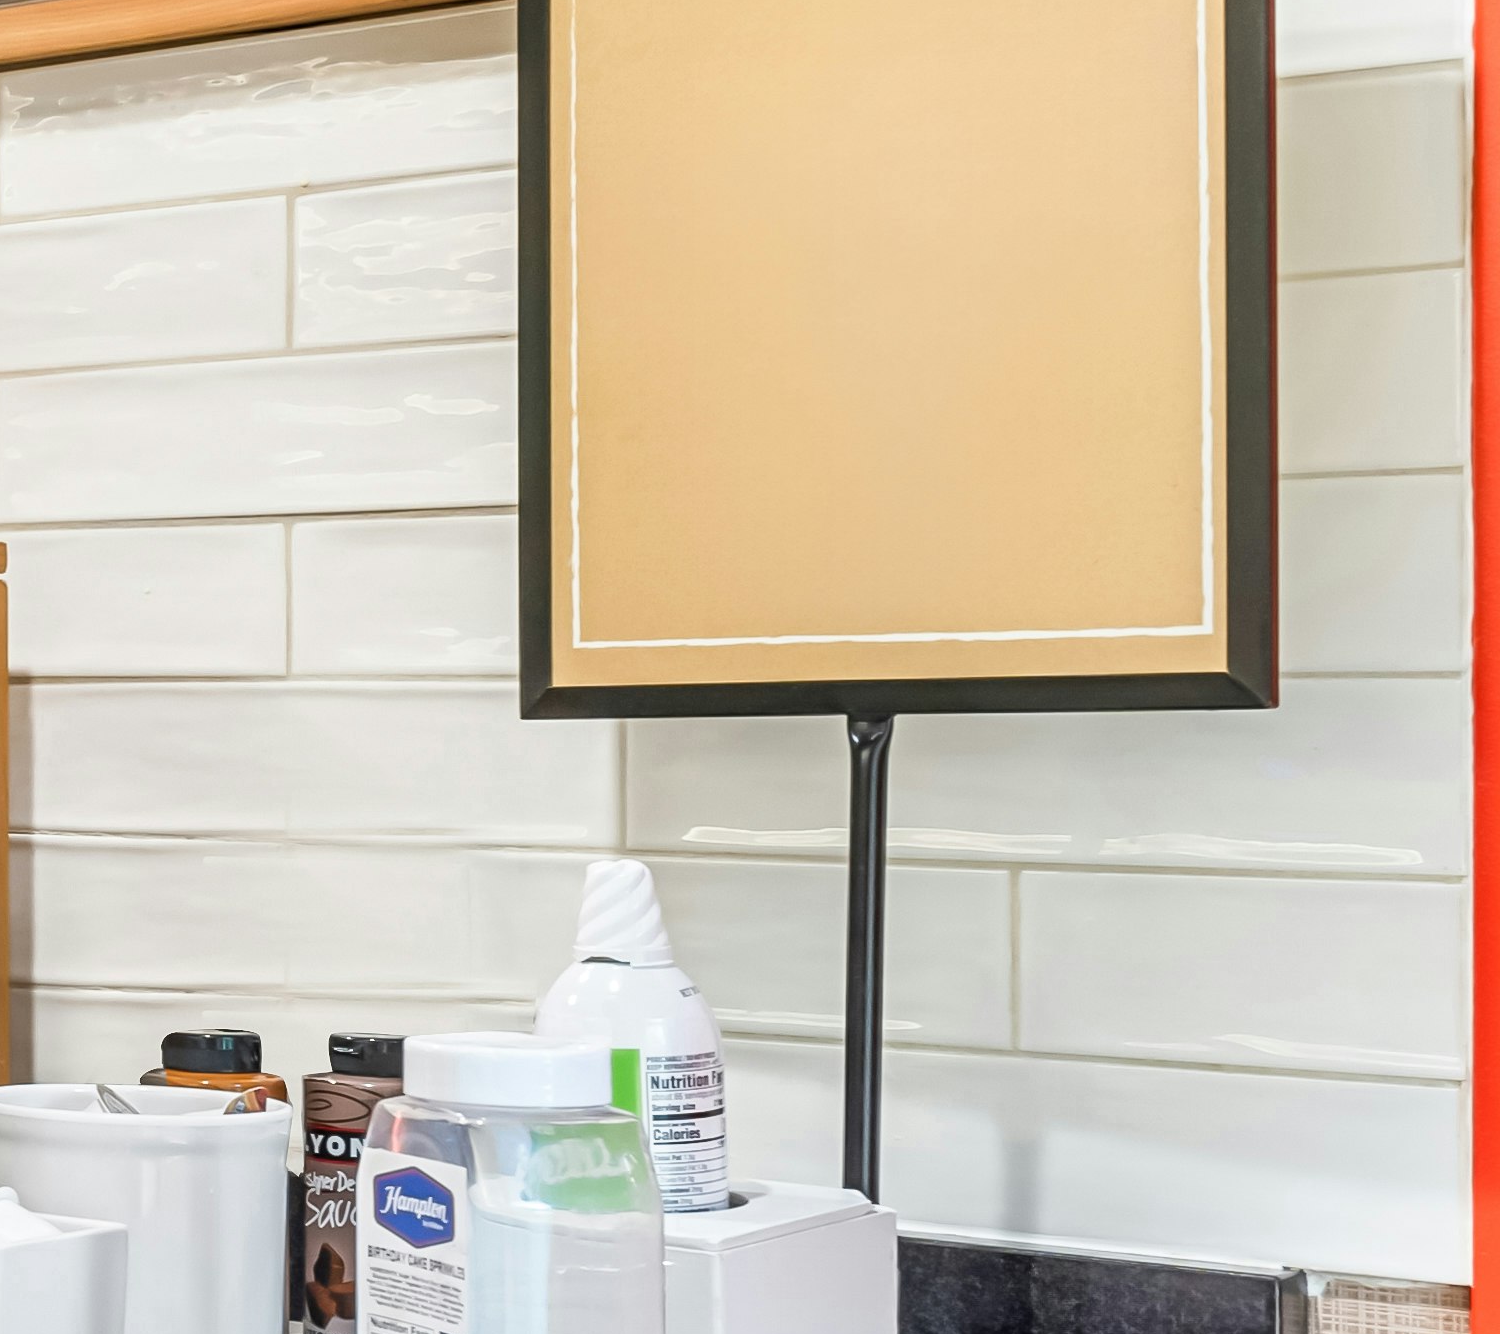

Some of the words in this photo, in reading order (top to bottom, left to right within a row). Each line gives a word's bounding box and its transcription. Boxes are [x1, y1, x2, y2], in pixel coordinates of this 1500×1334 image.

[650, 1074, 709, 1090] Nutrition
[653, 1127, 701, 1141] Calories
[305, 1133, 367, 1158] YON
[379, 1185, 449, 1224] Hampton
